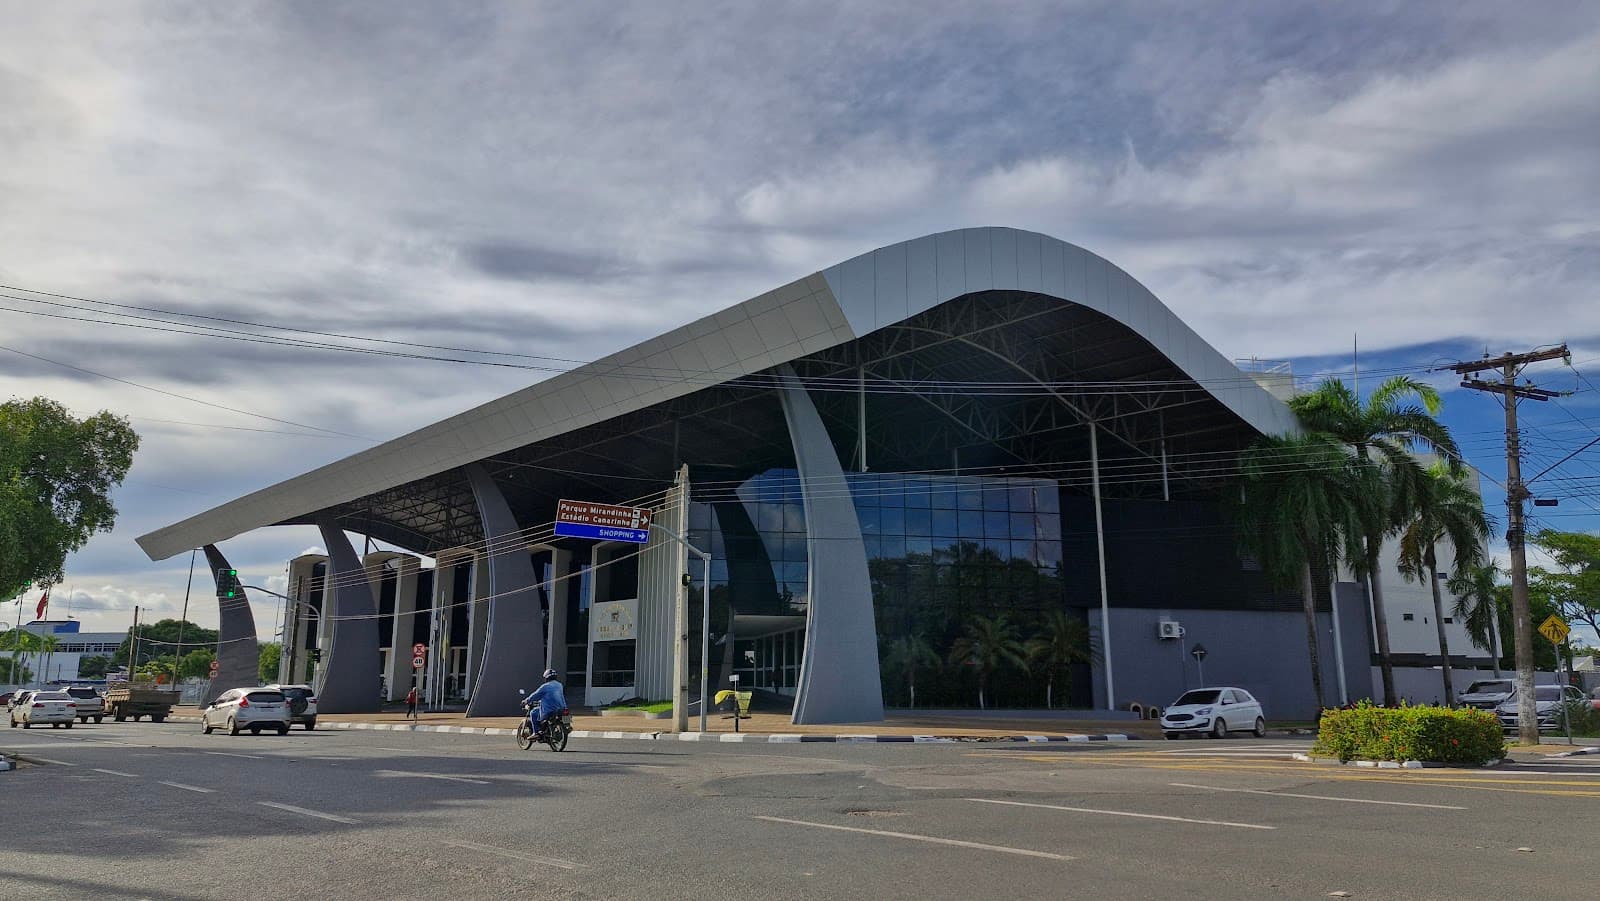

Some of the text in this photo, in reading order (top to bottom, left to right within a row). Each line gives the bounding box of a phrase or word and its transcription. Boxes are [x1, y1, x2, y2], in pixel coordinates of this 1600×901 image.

[561, 503, 632, 518] Parque Mirandinha
[561, 512, 589, 522] Estádio
[599, 529, 634, 538] SHOPPING
